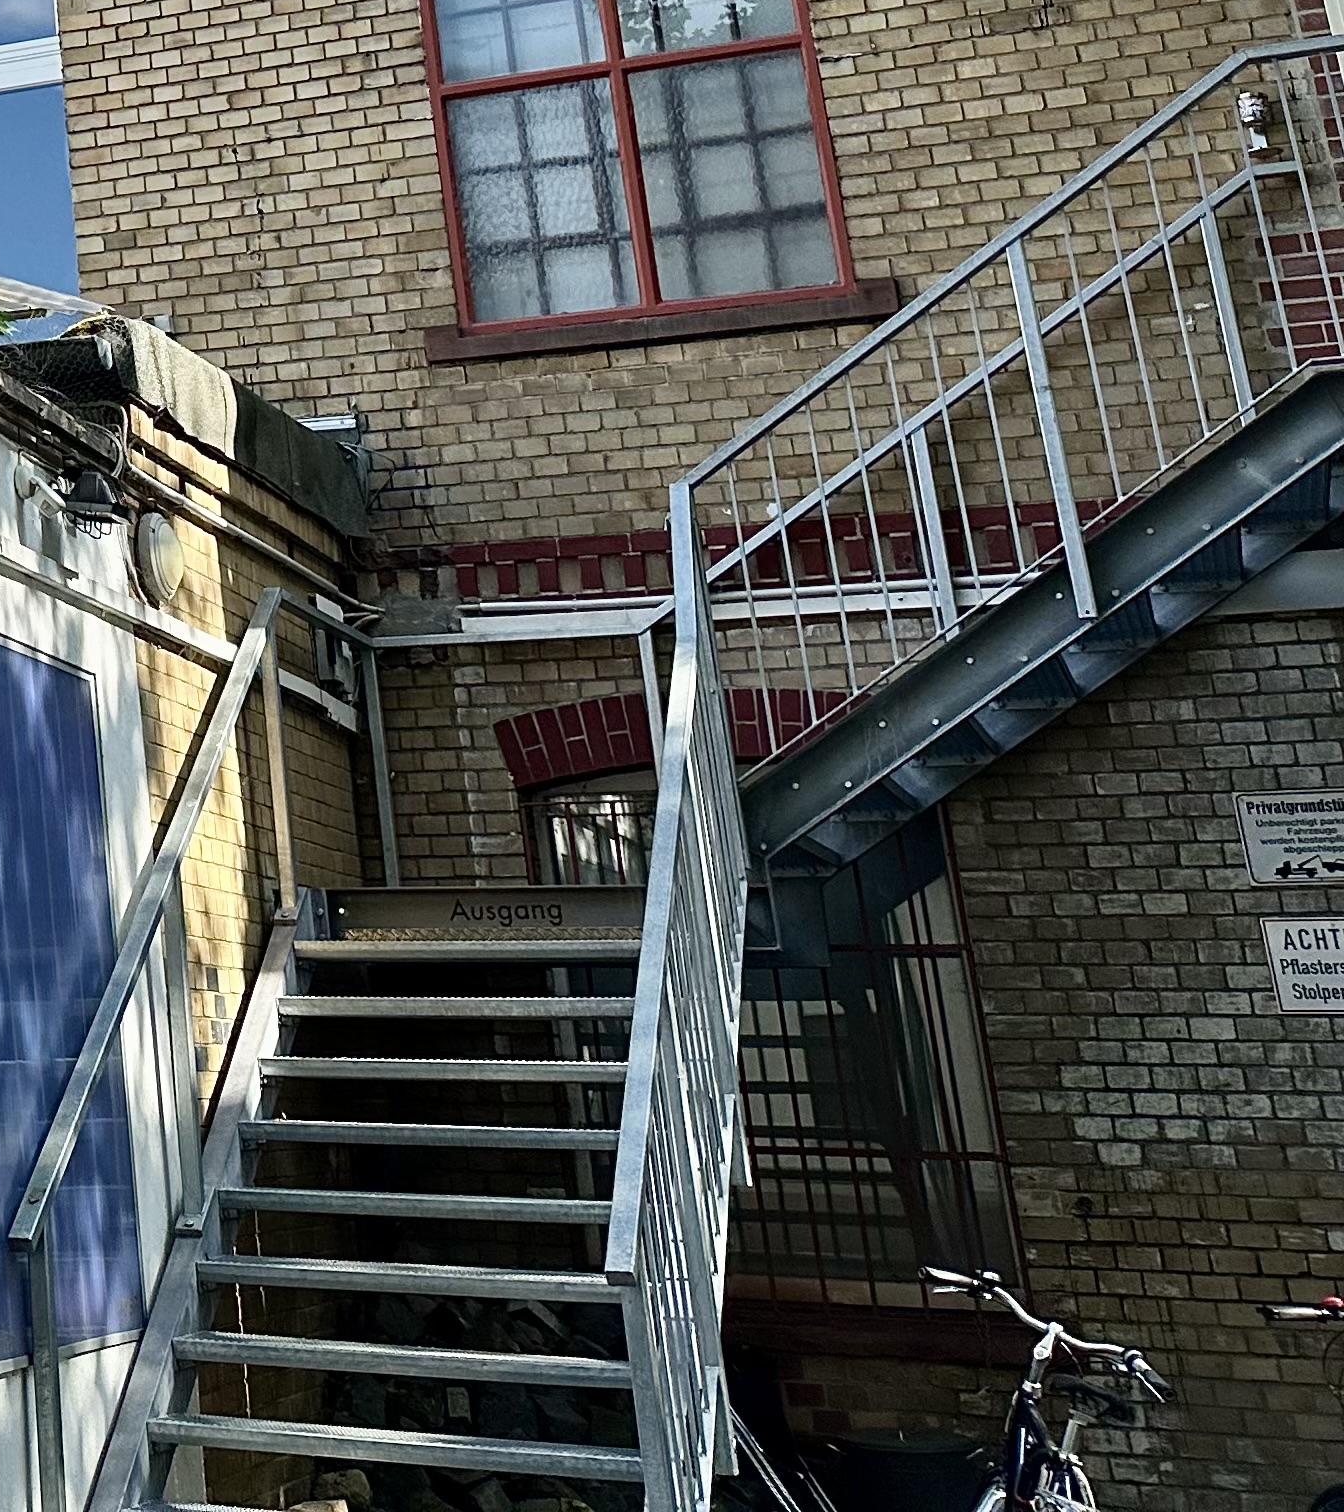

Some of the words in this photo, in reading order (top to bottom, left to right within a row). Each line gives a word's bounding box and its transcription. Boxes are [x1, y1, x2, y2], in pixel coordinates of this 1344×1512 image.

[1287, 828, 1337, 836] Fahrzeuge
[1260, 837, 1296, 845] werden
[450, 899, 563, 927] Ausgang
[1283, 928, 1344, 950] ACHT
